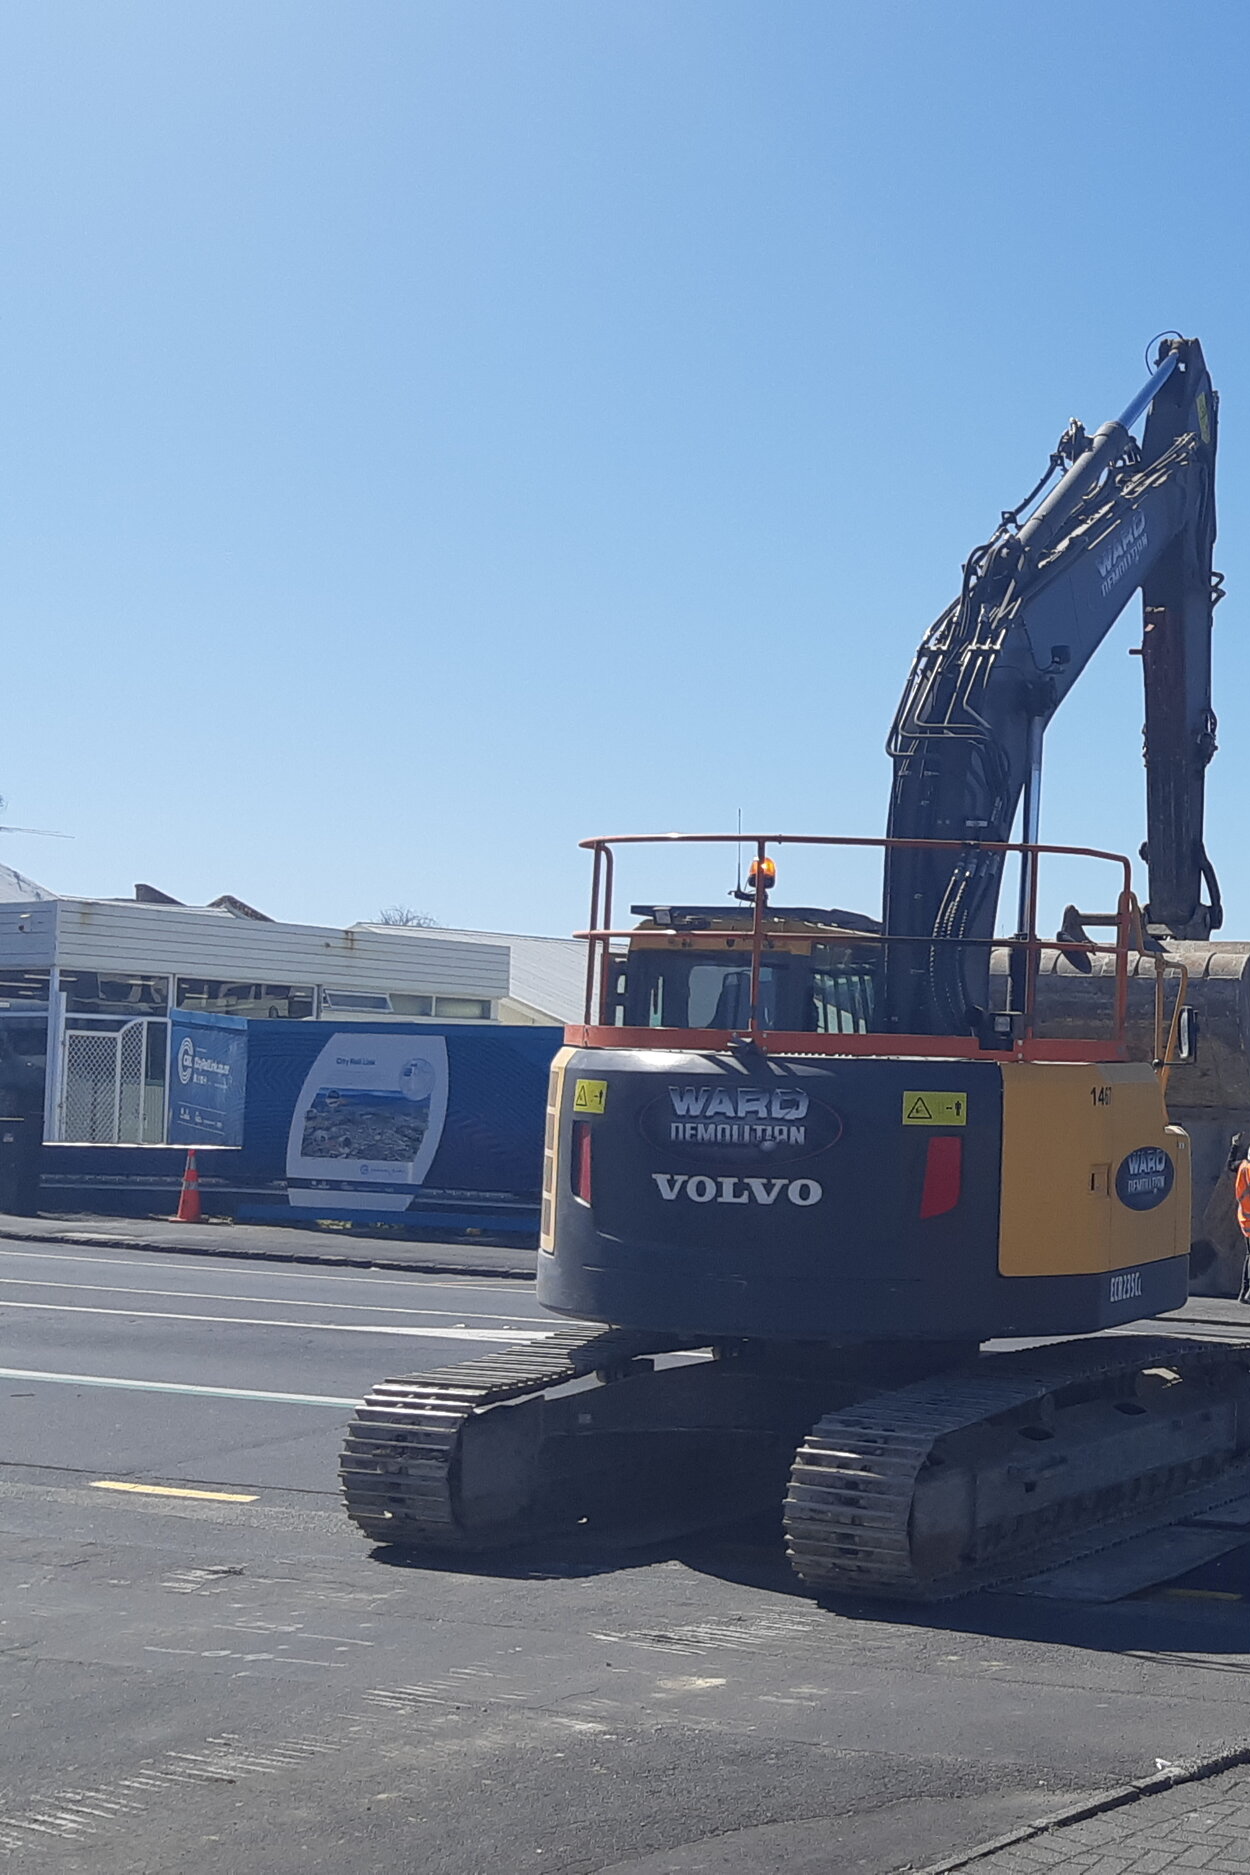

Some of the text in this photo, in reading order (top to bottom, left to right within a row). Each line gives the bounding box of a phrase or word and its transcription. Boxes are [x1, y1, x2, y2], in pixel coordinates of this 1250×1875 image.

[1096, 509, 1146, 577] WARD
[668, 1086, 810, 1121] WARD
[670, 1123, 806, 1146] DEMOLITION
[1128, 1150, 1166, 1175] WARD
[652, 1173, 823, 1206] VOLVO
[1127, 1175, 1166, 1193] DEMOLITION
